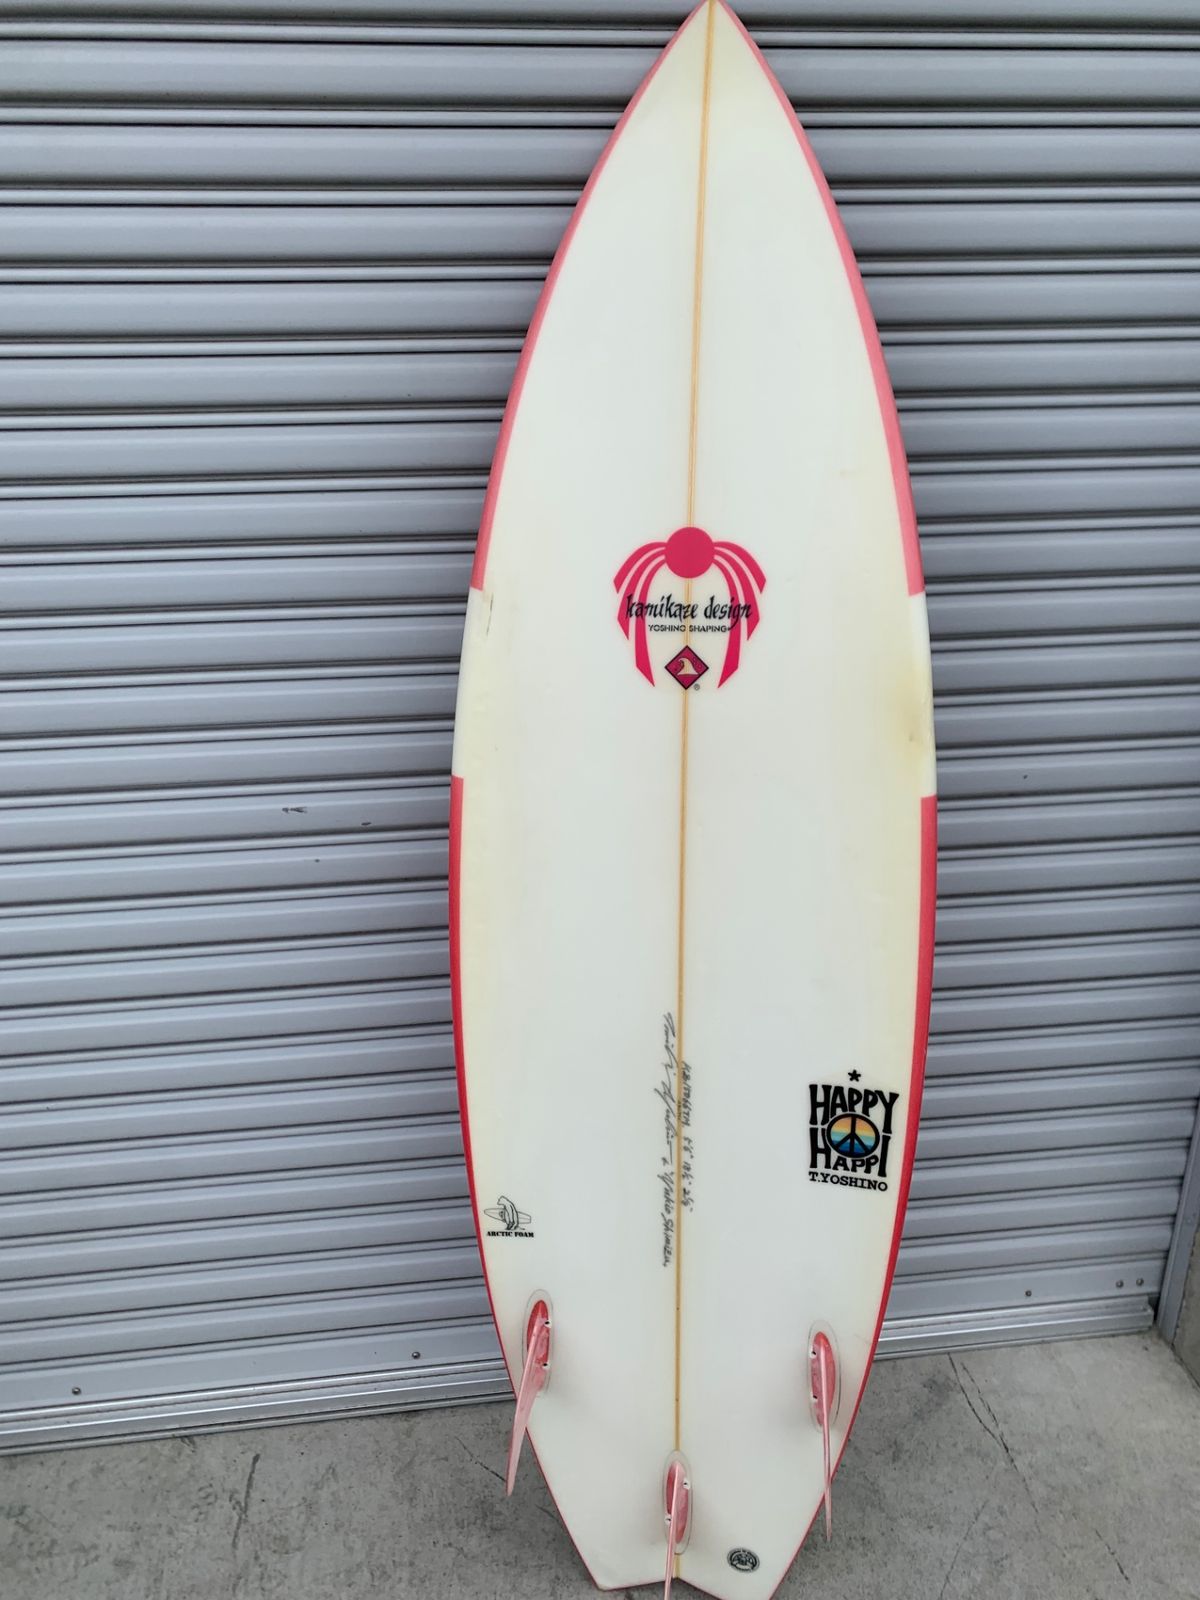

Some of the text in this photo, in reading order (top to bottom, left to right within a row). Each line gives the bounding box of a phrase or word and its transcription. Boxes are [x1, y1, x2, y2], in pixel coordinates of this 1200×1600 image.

[625, 593, 753, 631] kamikaze design
[648, 624, 728, 633] YOSHINO SHAPING
[809, 1084, 900, 1134] HAPPY
[809, 1127, 891, 1177] HAPPI
[808, 1171, 888, 1192] T.YOSHINO
